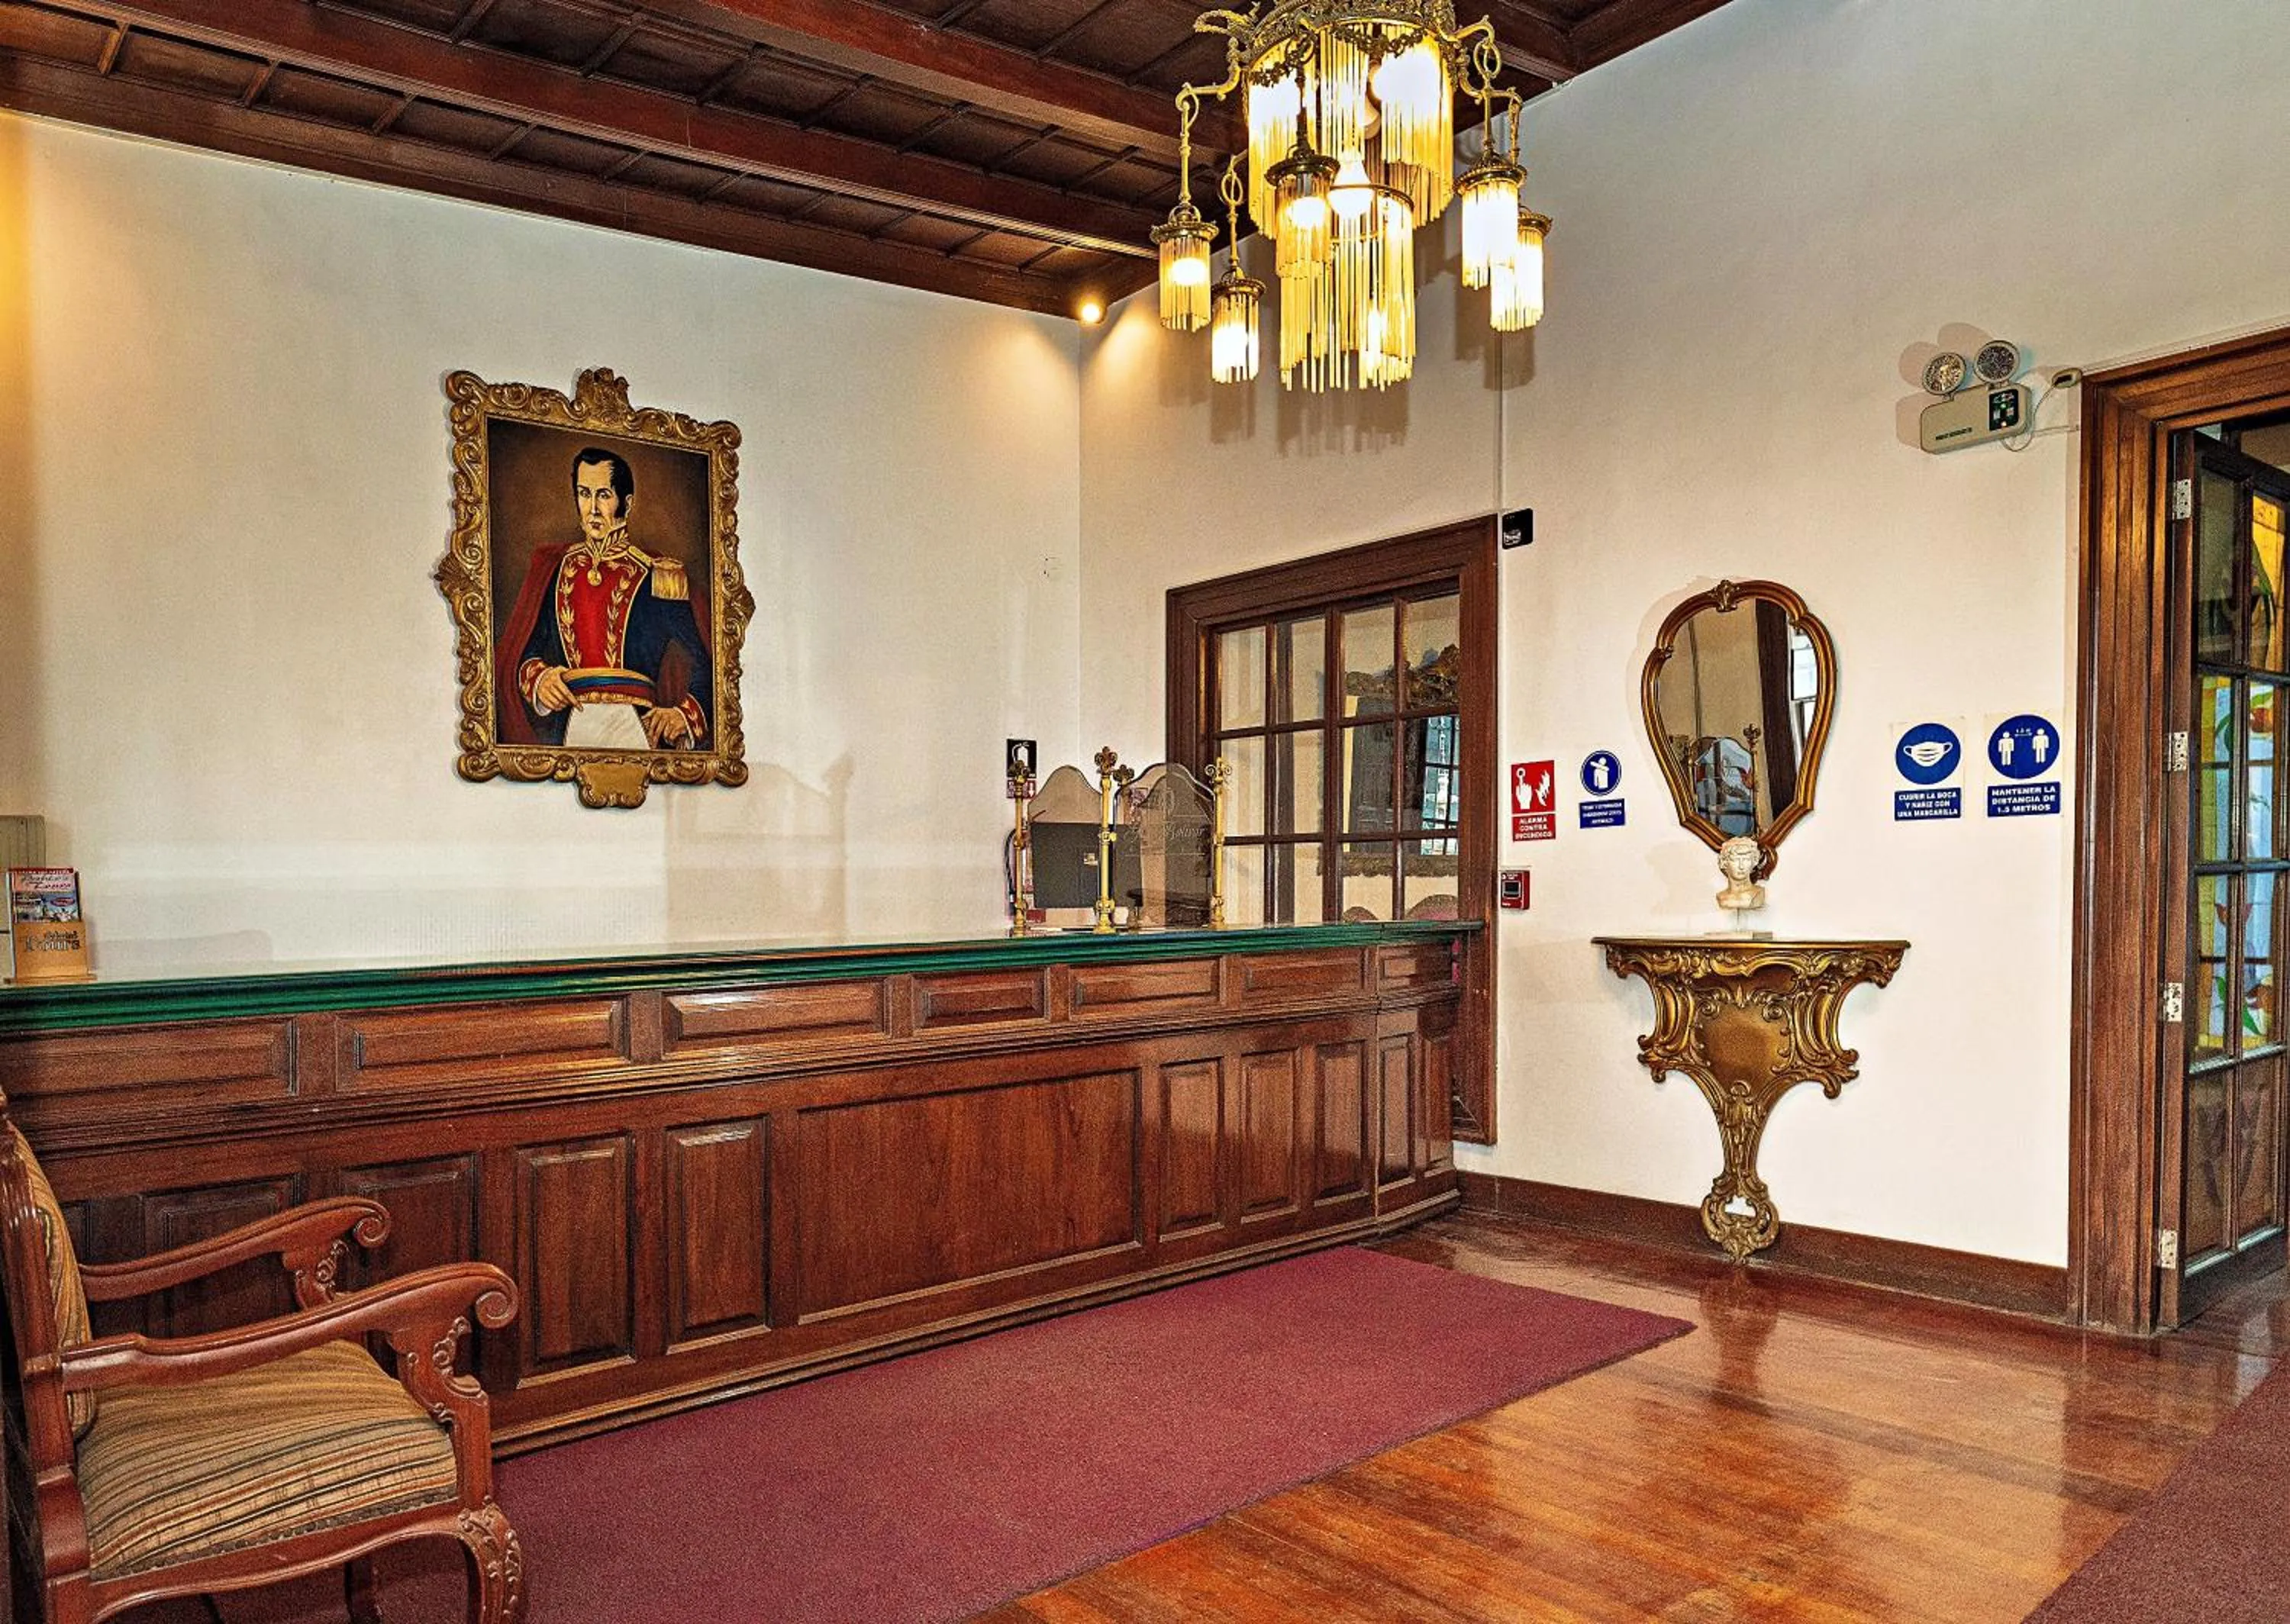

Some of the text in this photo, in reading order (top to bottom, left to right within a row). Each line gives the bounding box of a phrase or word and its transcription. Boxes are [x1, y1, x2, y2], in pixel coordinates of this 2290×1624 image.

[1992, 787, 2042, 796] MANTENER
[1992, 796, 2040, 804] DISTANCIA
[1914, 808, 1958, 817] MASCARILLA
[2012, 804, 2051, 813] METROS
[1520, 816, 1547, 824] ALARMA
[1520, 823, 1547, 832] CONTRA
